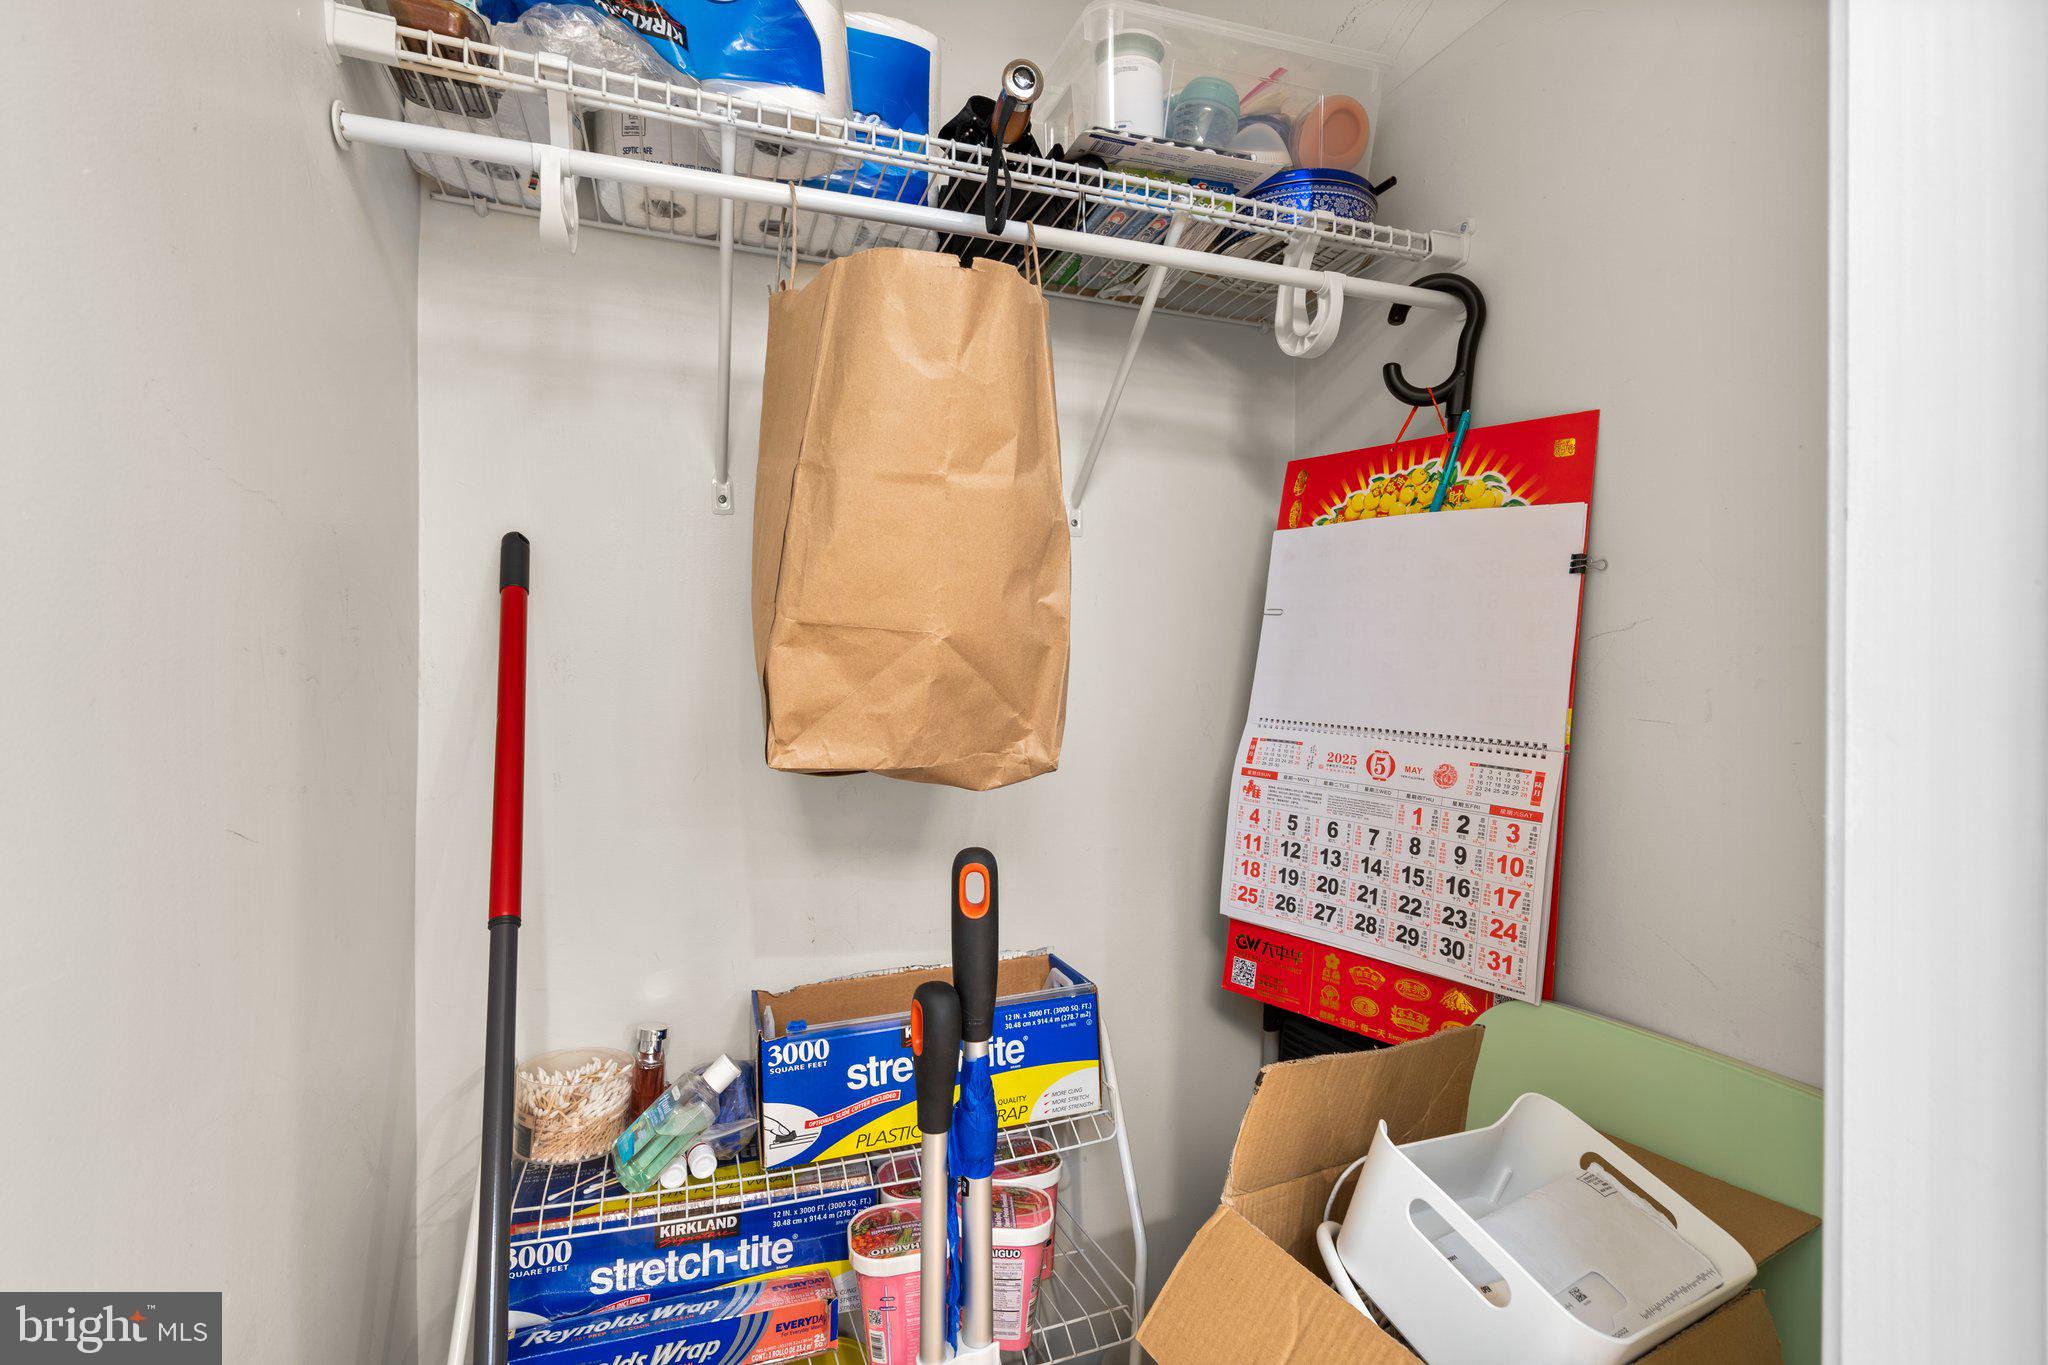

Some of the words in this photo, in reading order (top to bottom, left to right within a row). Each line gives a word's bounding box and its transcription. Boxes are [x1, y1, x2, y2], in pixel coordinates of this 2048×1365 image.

[622, 146, 638, 154] SEPTIC
[1327, 752, 1358, 766] 2025
[1374, 756, 1386, 775] 5
[1404, 766, 1423, 774] MAY
[1413, 808, 1422, 825] 1
[1456, 815, 1470, 835] 2
[1506, 824, 1520, 843] 3
[1250, 808, 1260, 824] 4
[1287, 814, 1298, 831] 5
[1327, 821, 1338, 838] 6
[1369, 828, 1379, 846] 7
[1409, 837, 1421, 855] 8
[1454, 846, 1466, 865] 9
[1497, 855, 1524, 877] 10
[1244, 834, 1261, 851] 11
[1281, 841, 1301, 859] 12
[1320, 848, 1341, 867] 13
[1361, 856, 1382, 876] 14
[1402, 866, 1424, 886] 15
[1446, 876, 1470, 898] 16
[1494, 887, 1521, 909] 17
[1241, 860, 1260, 877] 18
[1279, 868, 1299, 886] 19
[1316, 876, 1339, 895] 20
[1357, 885, 1377, 905] 21
[1398, 895, 1422, 917] 22
[1442, 906, 1467, 929] 23
[1490, 918, 1518, 942] 24
[1238, 885, 1258, 904] 25
[1275, 894, 1296, 913] 26
[1314, 903, 1336, 922] 27
[1354, 913, 1377, 934] 28
[1395, 925, 1419, 946] 29
[1440, 937, 1465, 960] 30
[1487, 950, 1512, 974] 31
[1054, 1006, 1069, 1015] (3000
[1071, 1005, 1080, 1013] SQ.
[1005, 1022, 1021, 1030] 30.48
[1037, 1017, 1053, 1025] 914.4
[1061, 1013, 1079, 1022] (278.7
[768, 1038, 830, 1067] 3000
[769, 1064, 804, 1074] SQUARE
[808, 1060, 828, 1069] FEET
[809, 1116, 834, 1127] OPTIONAL
[836, 1109, 850, 1118] SLIDE
[852, 1100, 870, 1113] CUTTER
[871, 1092, 896, 1104] INCLUDED
[998, 1095, 1027, 1105] QUALITY
[1069, 1101, 1094, 1110] STRENGTH
[998, 1106, 1028, 1122] RAP
[856, 1124, 922, 1149] PLASTIC
[800, 1206, 816, 1215] 3000
[828, 1202, 846, 1212] (3000
[848, 1201, 859, 1210] SQ.
[861, 1198, 872, 1207] FT.)
[660, 1216, 737, 1238] KIRKLAND
[773, 1219, 791, 1228] 30.48
[808, 1214, 827, 1223] 914.4
[836, 1209, 857, 1219] (278.7
[509, 1268, 542, 1279] QUARE
[546, 1264, 569, 1273] FEET
[589, 1236, 794, 1295] stretch-tite
[772, 1277, 825, 1292] EVERYDAY
[520, 1312, 648, 1344] Reynolds
[650, 1300, 719, 1322] Wrap
[776, 1314, 826, 1333] EVERYDA
[652, 1340, 719, 1364] Wrap
[771, 1348, 788, 1357] ROLLO
